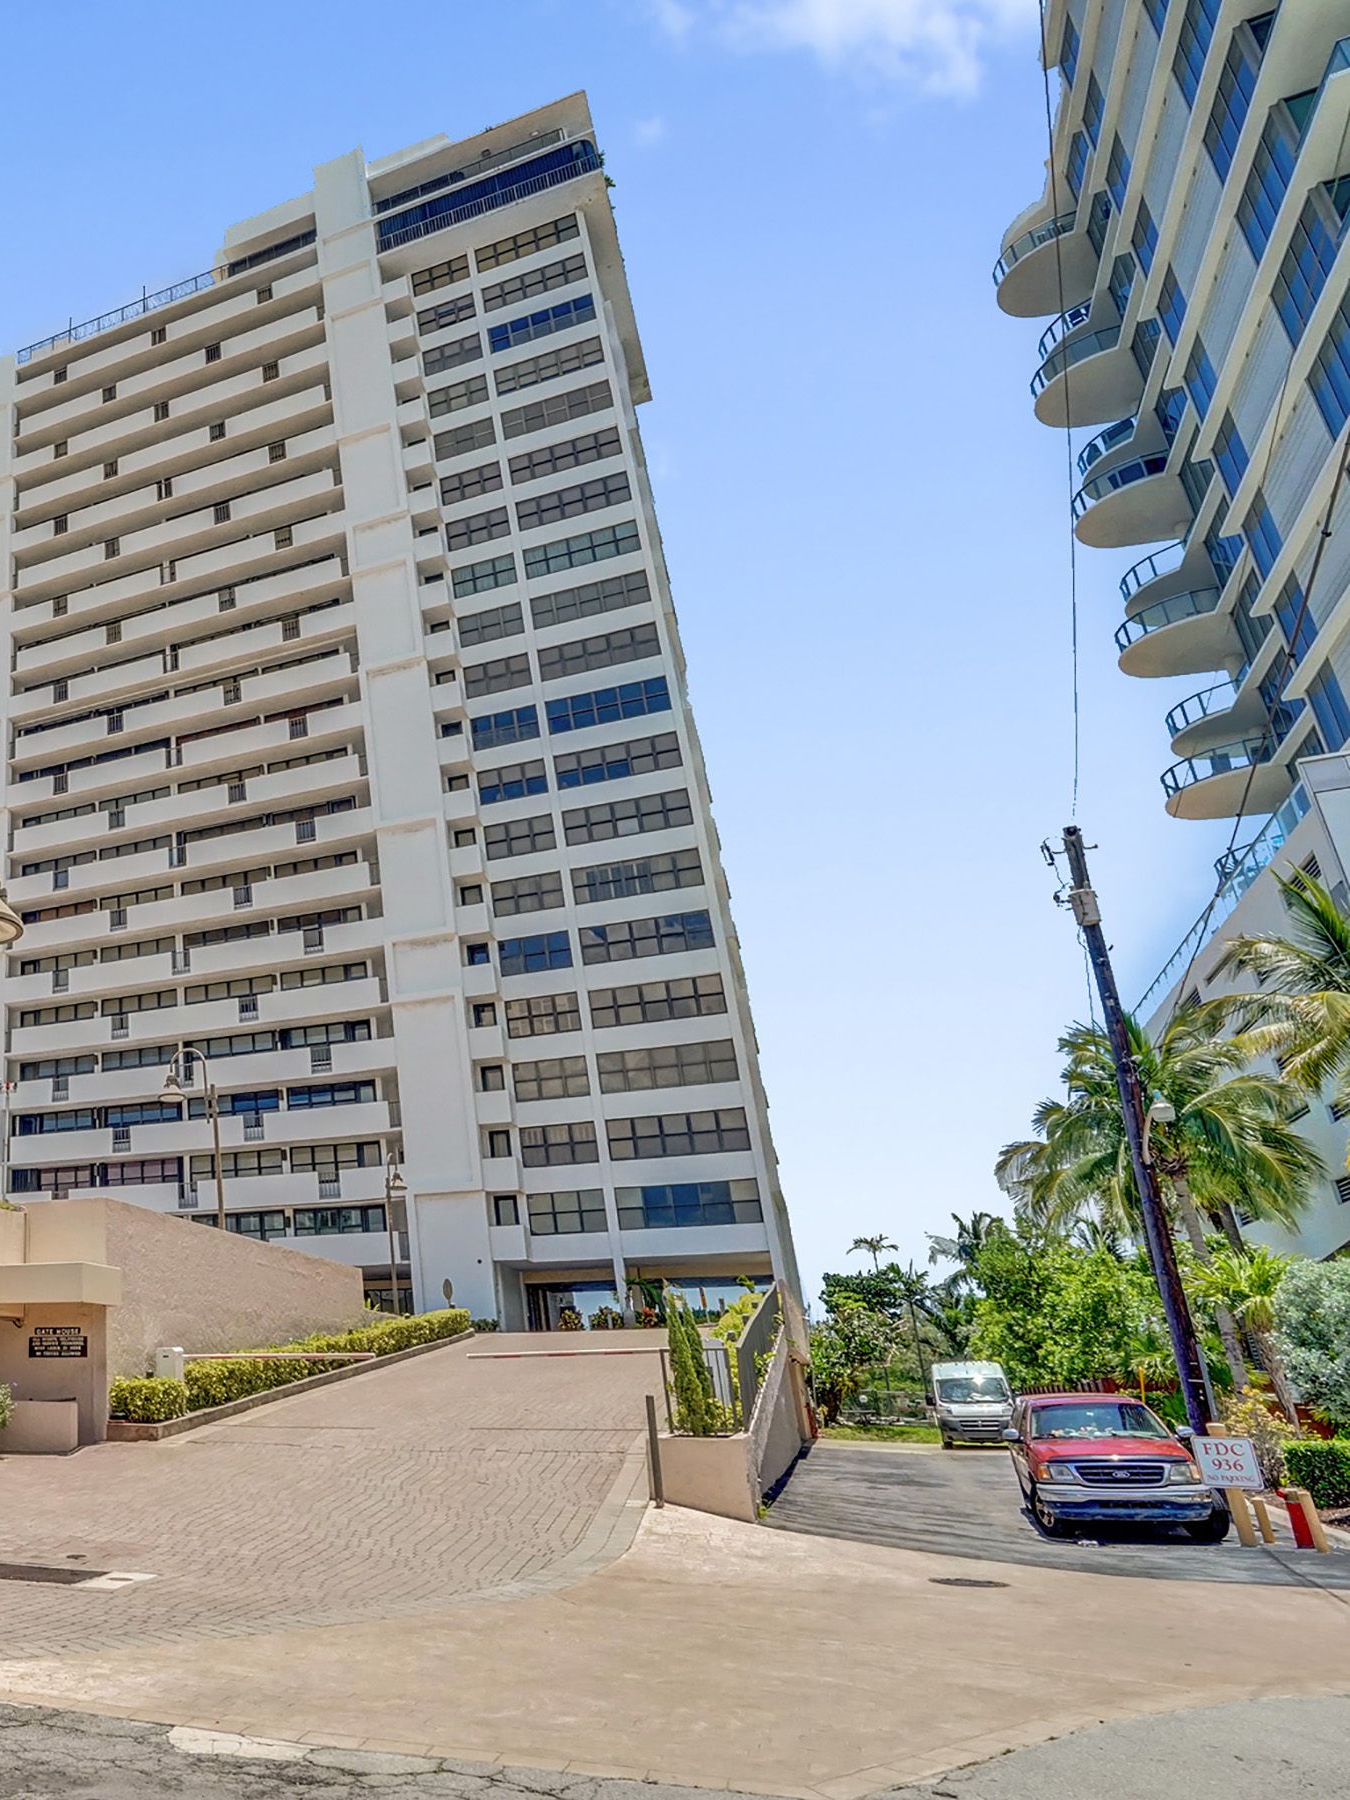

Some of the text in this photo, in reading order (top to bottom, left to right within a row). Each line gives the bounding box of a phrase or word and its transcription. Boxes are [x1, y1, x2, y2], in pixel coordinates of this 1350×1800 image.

[1202, 1442, 1244, 1456] FDC
[1211, 1458, 1244, 1472] 936
[1220, 1474, 1255, 1483] PARKING
